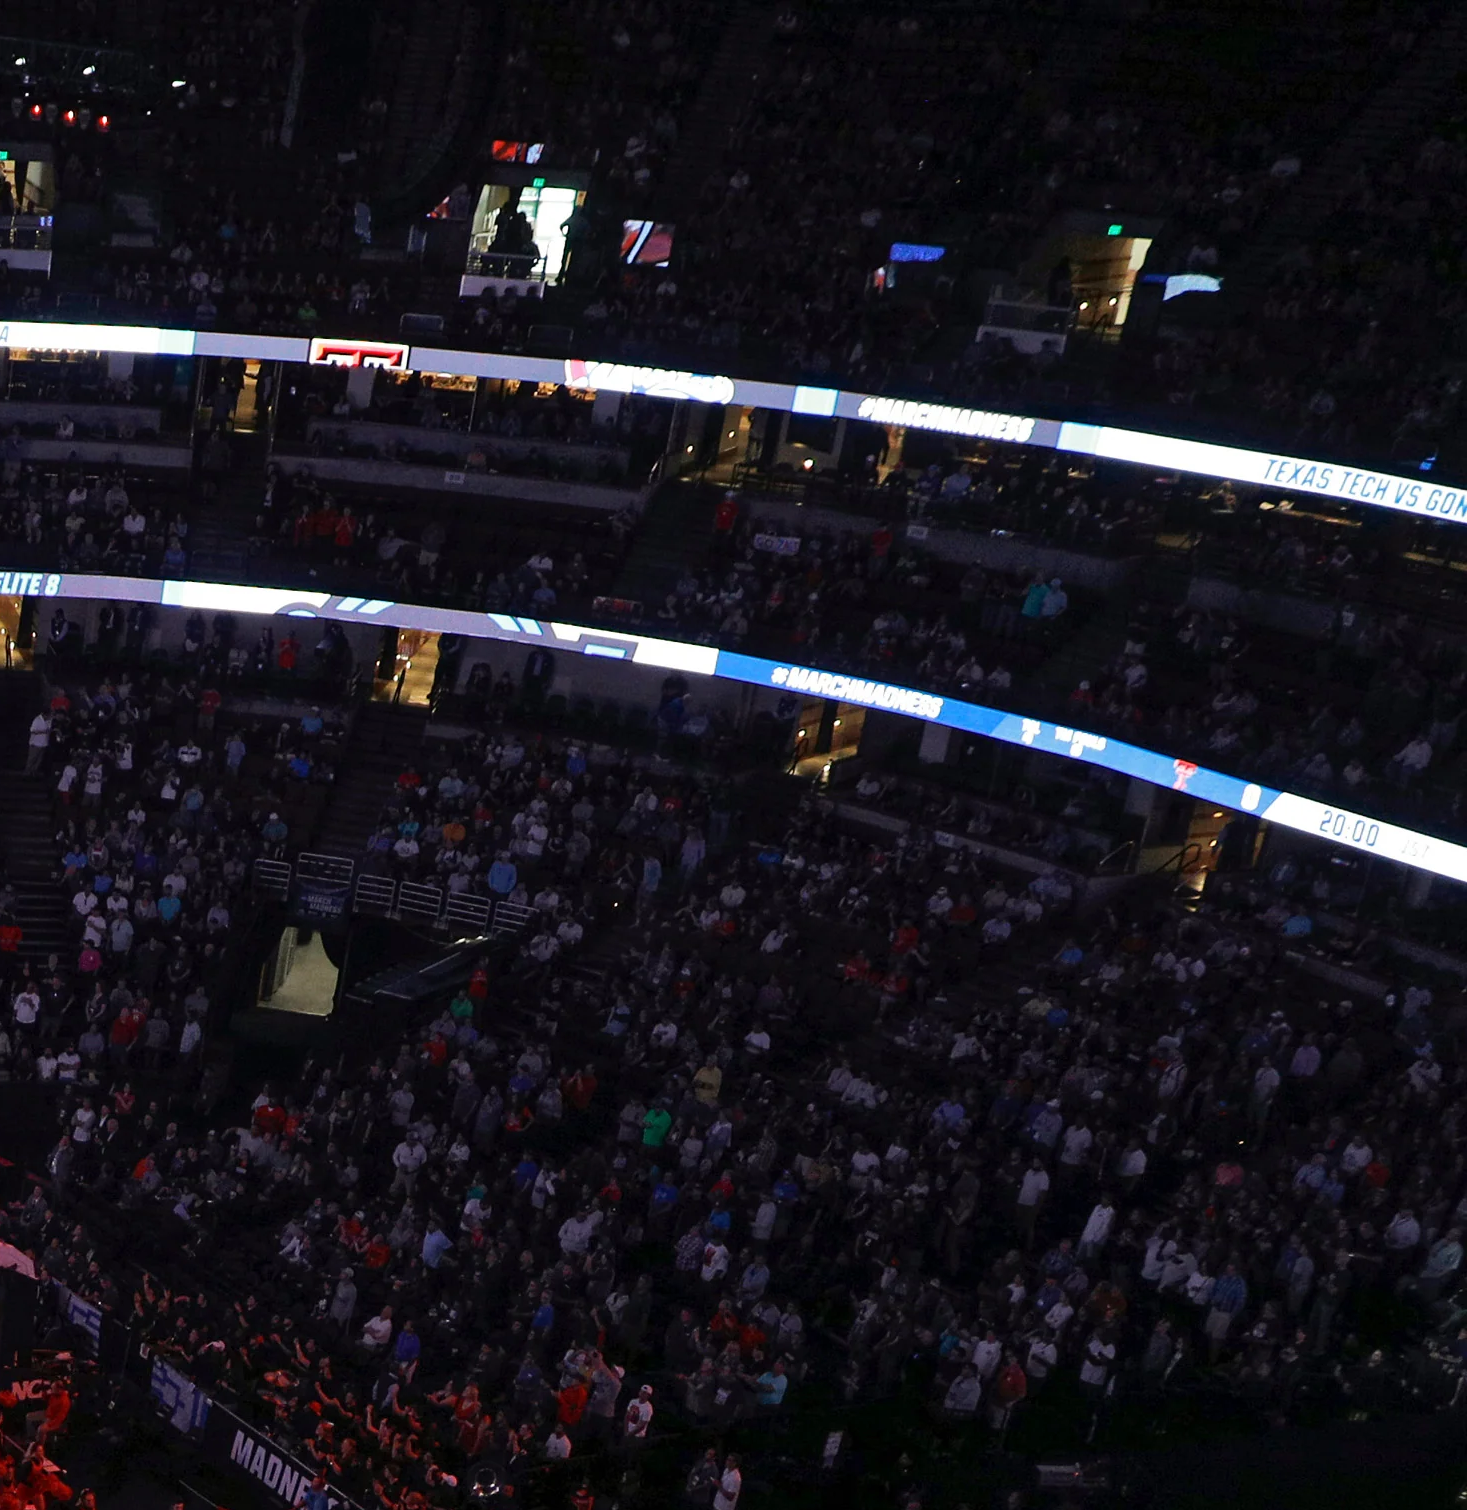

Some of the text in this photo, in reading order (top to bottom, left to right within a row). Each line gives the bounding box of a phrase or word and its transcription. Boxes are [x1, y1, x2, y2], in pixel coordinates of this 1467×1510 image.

[857, 395, 1036, 443] #MARCHMADNESS
[1263, 459, 1333, 489] TEXAS
[1339, 471, 1391, 501] TECH
[1395, 482, 1422, 507] VS
[45, 574, 61, 596] 8
[770, 666, 944, 719] #MARCHMADNESS
[1319, 810, 1380, 847] 20:00
